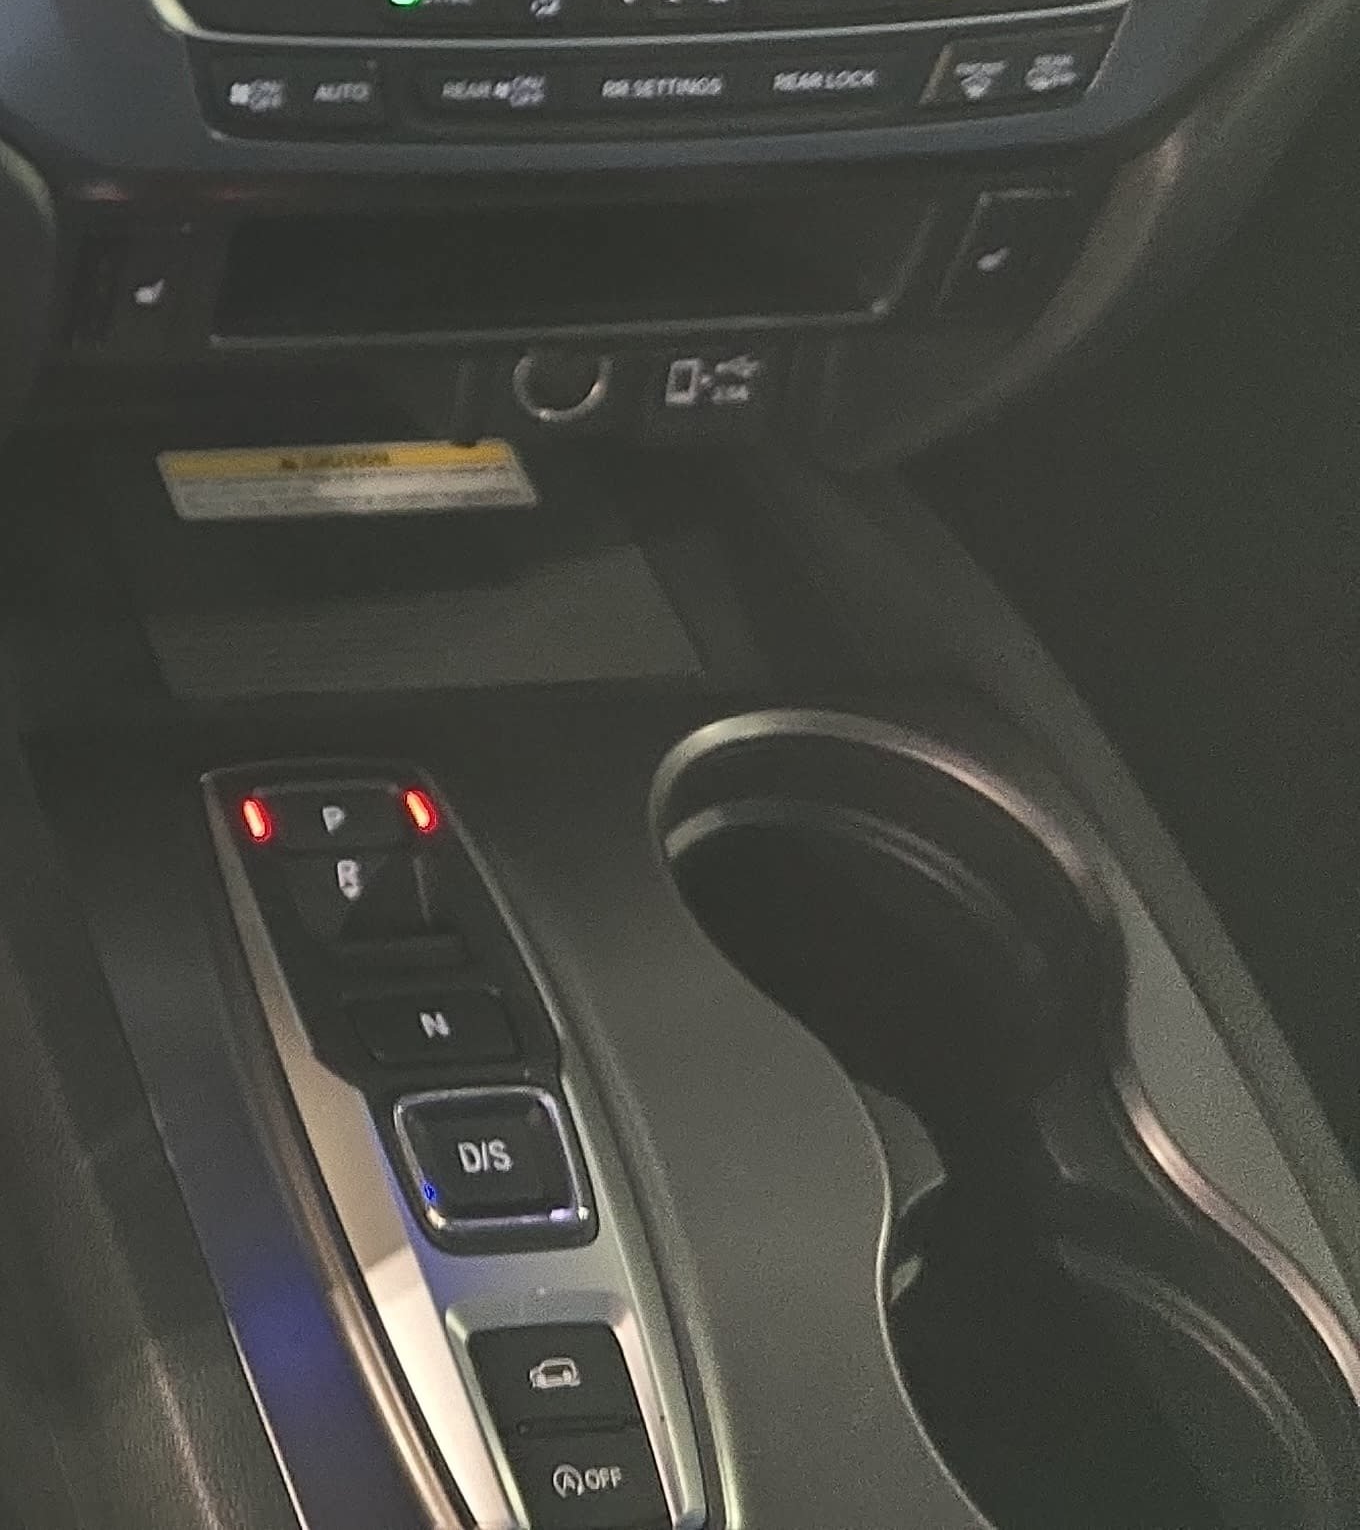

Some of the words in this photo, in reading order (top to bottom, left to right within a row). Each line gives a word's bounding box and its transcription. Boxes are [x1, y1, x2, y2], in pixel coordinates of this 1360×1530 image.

[314, 81, 371, 103] AUTO
[322, 806, 345, 835] P
[420, 1010, 452, 1040] N
[457, 1140, 513, 1173] D/S
[584, 1466, 622, 1490] OFF
